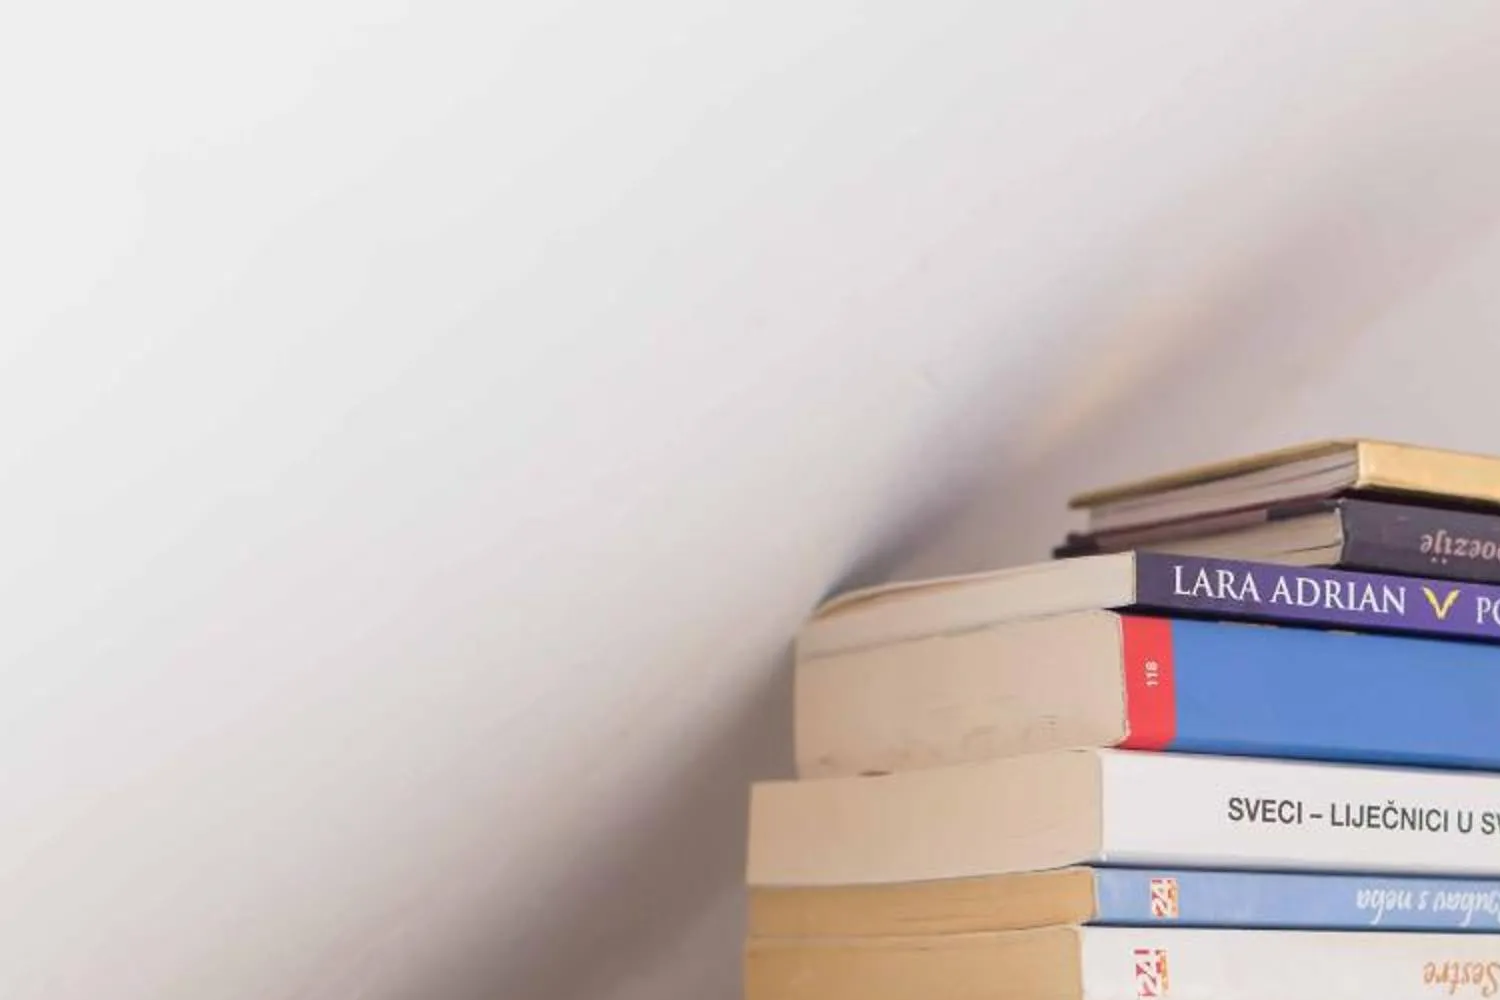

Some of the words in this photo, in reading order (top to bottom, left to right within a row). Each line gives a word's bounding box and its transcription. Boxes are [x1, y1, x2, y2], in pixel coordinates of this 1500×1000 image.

[1174, 565, 1260, 602] LARA
[1270, 576, 1406, 615] ADRIAN
[1228, 798, 1302, 824] SVECI
[1331, 800, 1448, 832] LIJEČNICI
[1458, 811, 1473, 834] U
[1356, 888, 1413, 926] neba
[1419, 890, 1429, 909] s
